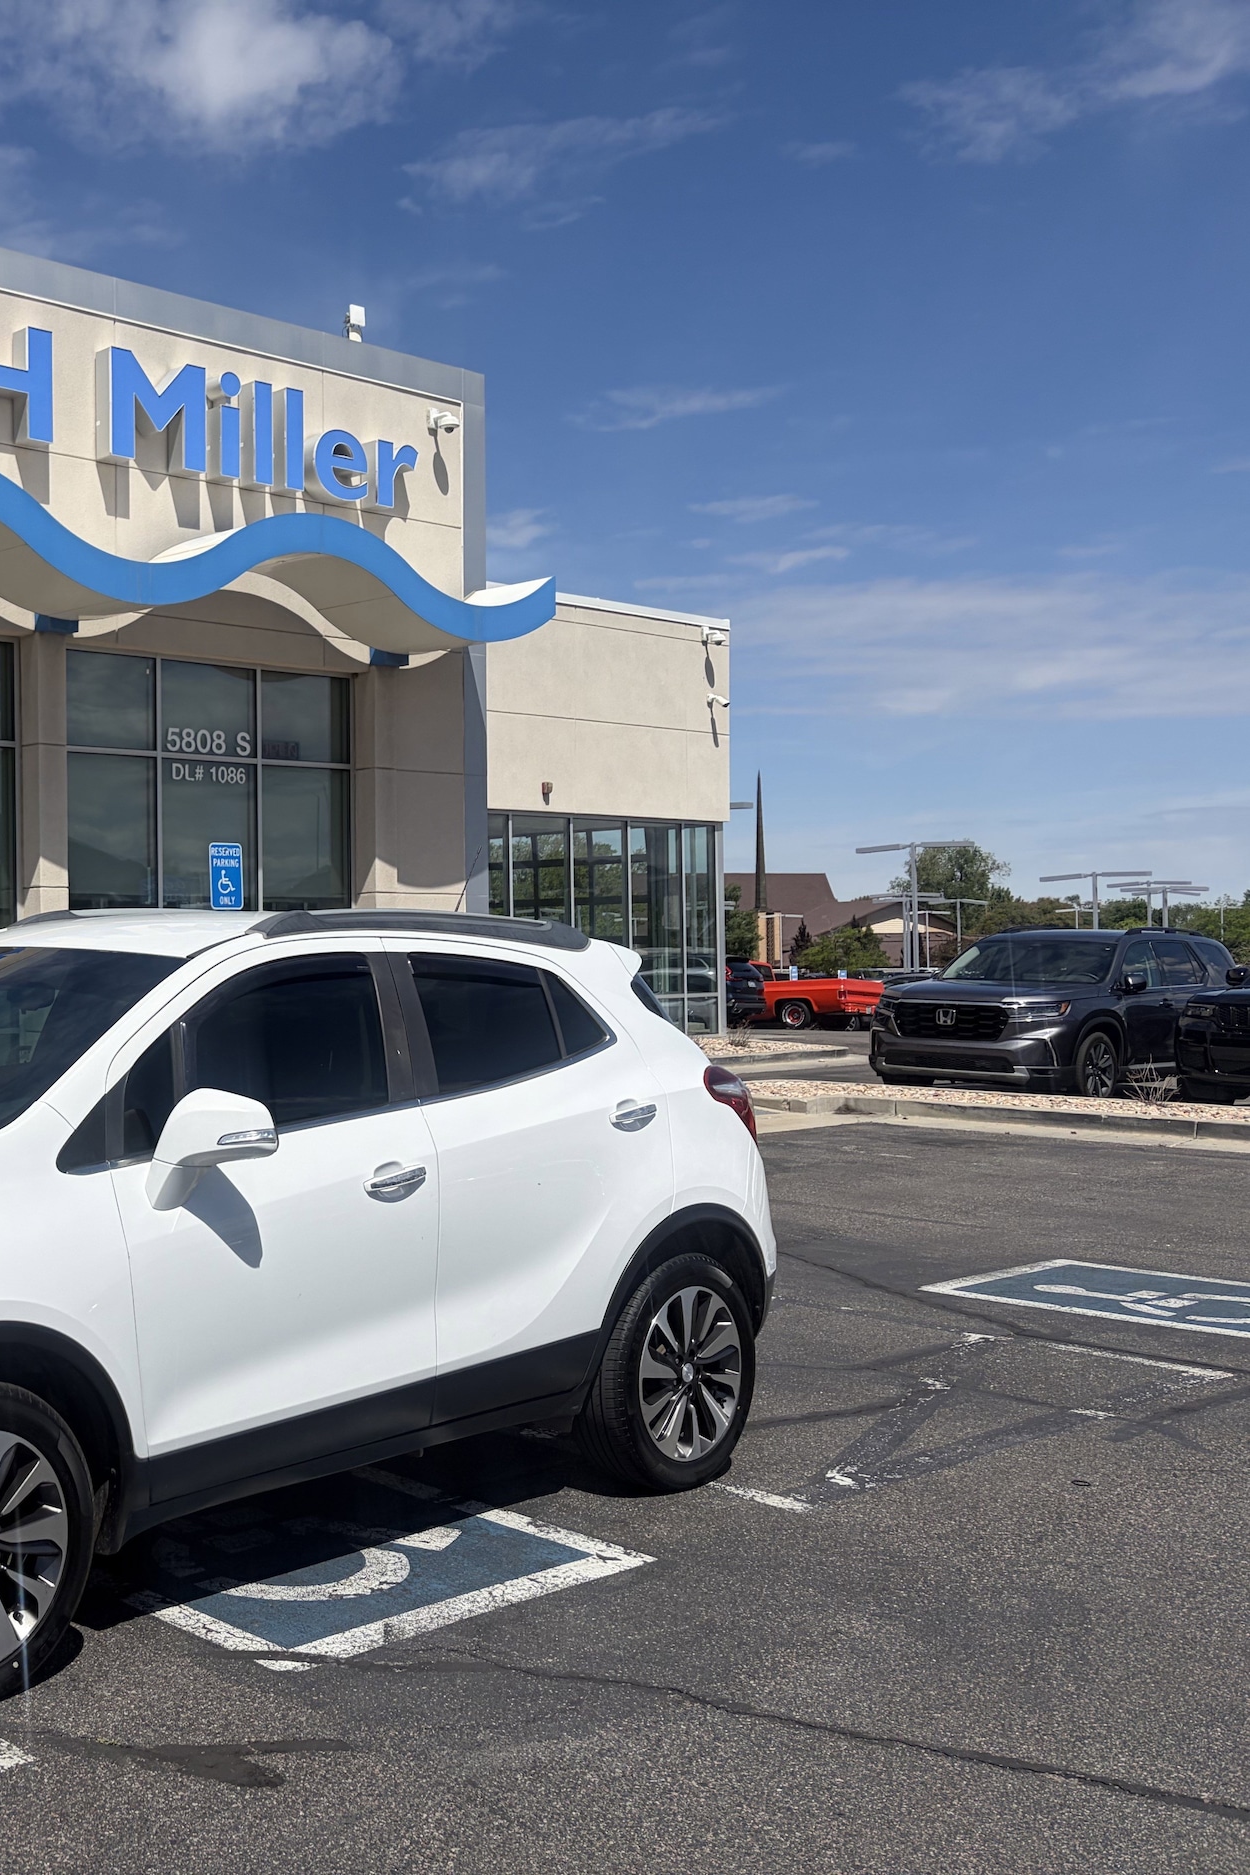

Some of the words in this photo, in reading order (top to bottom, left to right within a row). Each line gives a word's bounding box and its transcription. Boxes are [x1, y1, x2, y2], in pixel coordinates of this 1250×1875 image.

[108, 346, 419, 509] Miller
[166, 727, 226, 754] 5808
[236, 732, 251, 756] S
[172, 763, 204, 781] DL#
[210, 766, 246, 784] 1086
[211, 847, 240, 857] RESERVED
[213, 858, 239, 868] PARKING
[219, 896, 236, 905] ONLY
